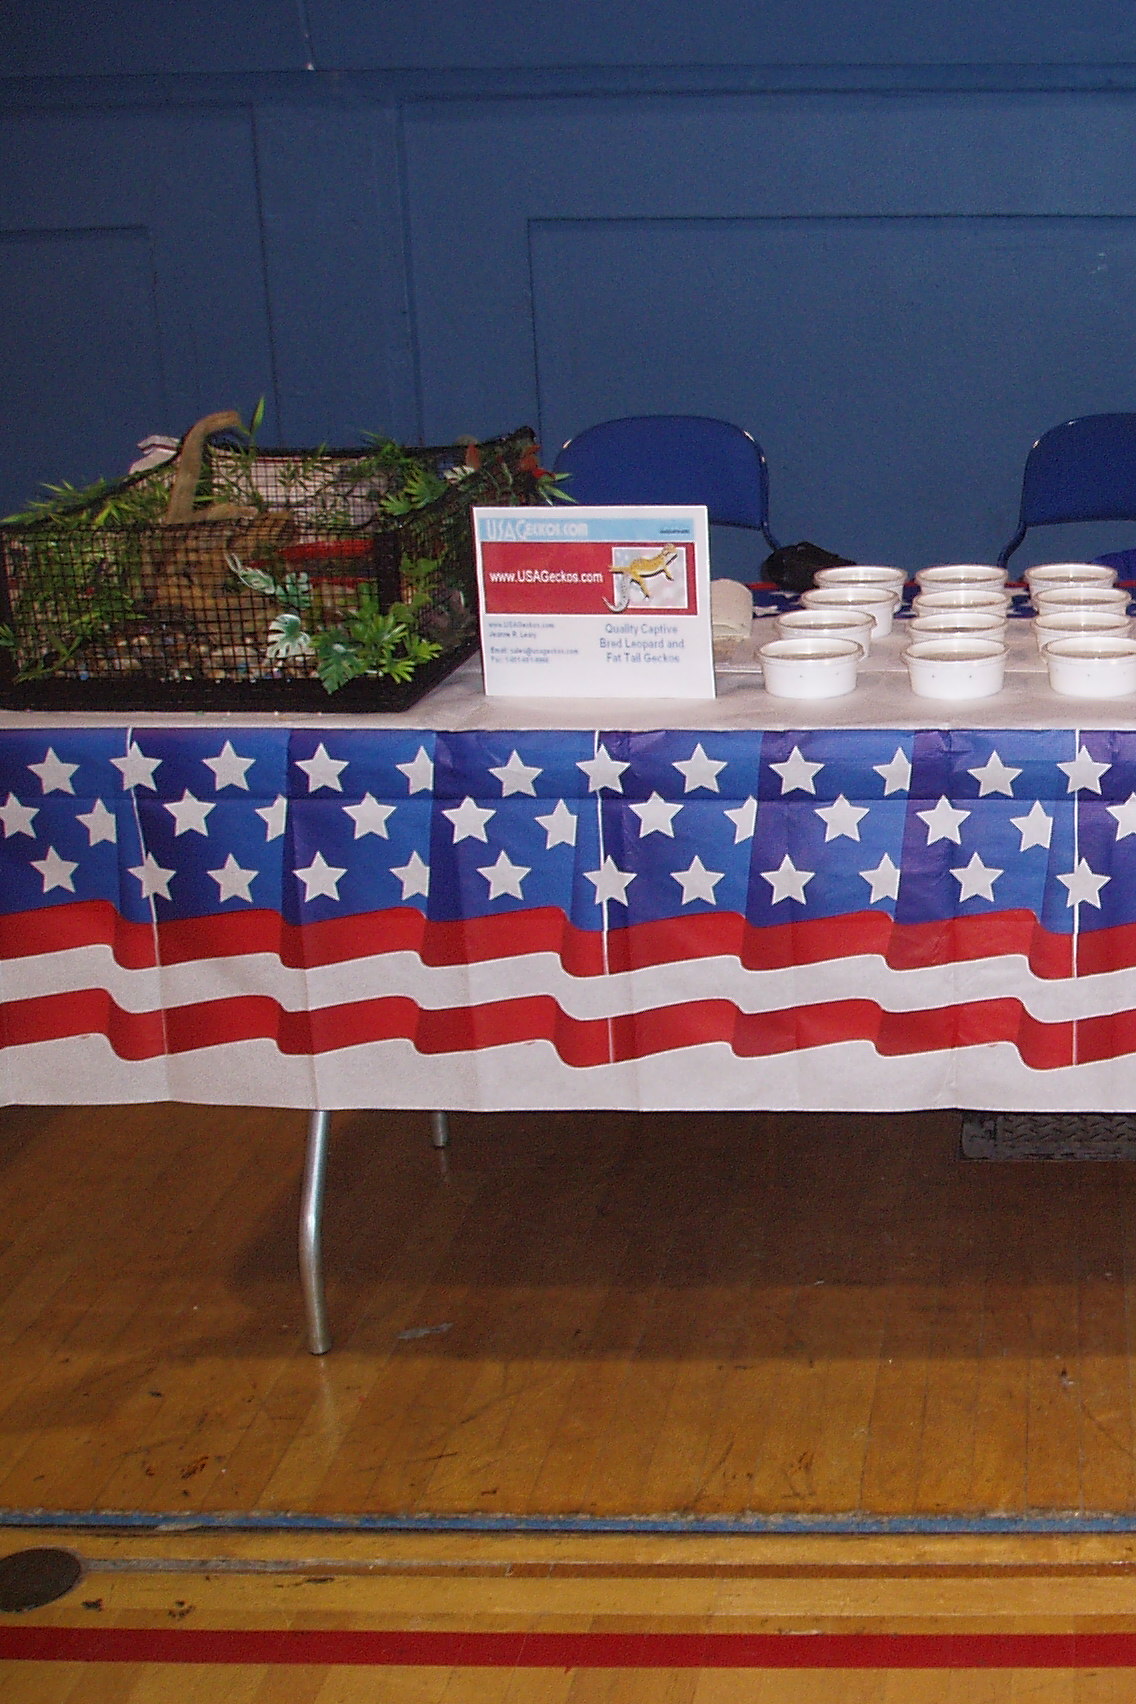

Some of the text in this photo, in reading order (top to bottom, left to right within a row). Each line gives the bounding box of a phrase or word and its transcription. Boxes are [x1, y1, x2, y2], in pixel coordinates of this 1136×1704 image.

[489, 570, 604, 583] www.USAGeckos.com
[605, 623, 678, 635] Quality Captive
[599, 637, 685, 650] Bred Leopard and
[606, 652, 680, 662] Fat Tail Geckos
